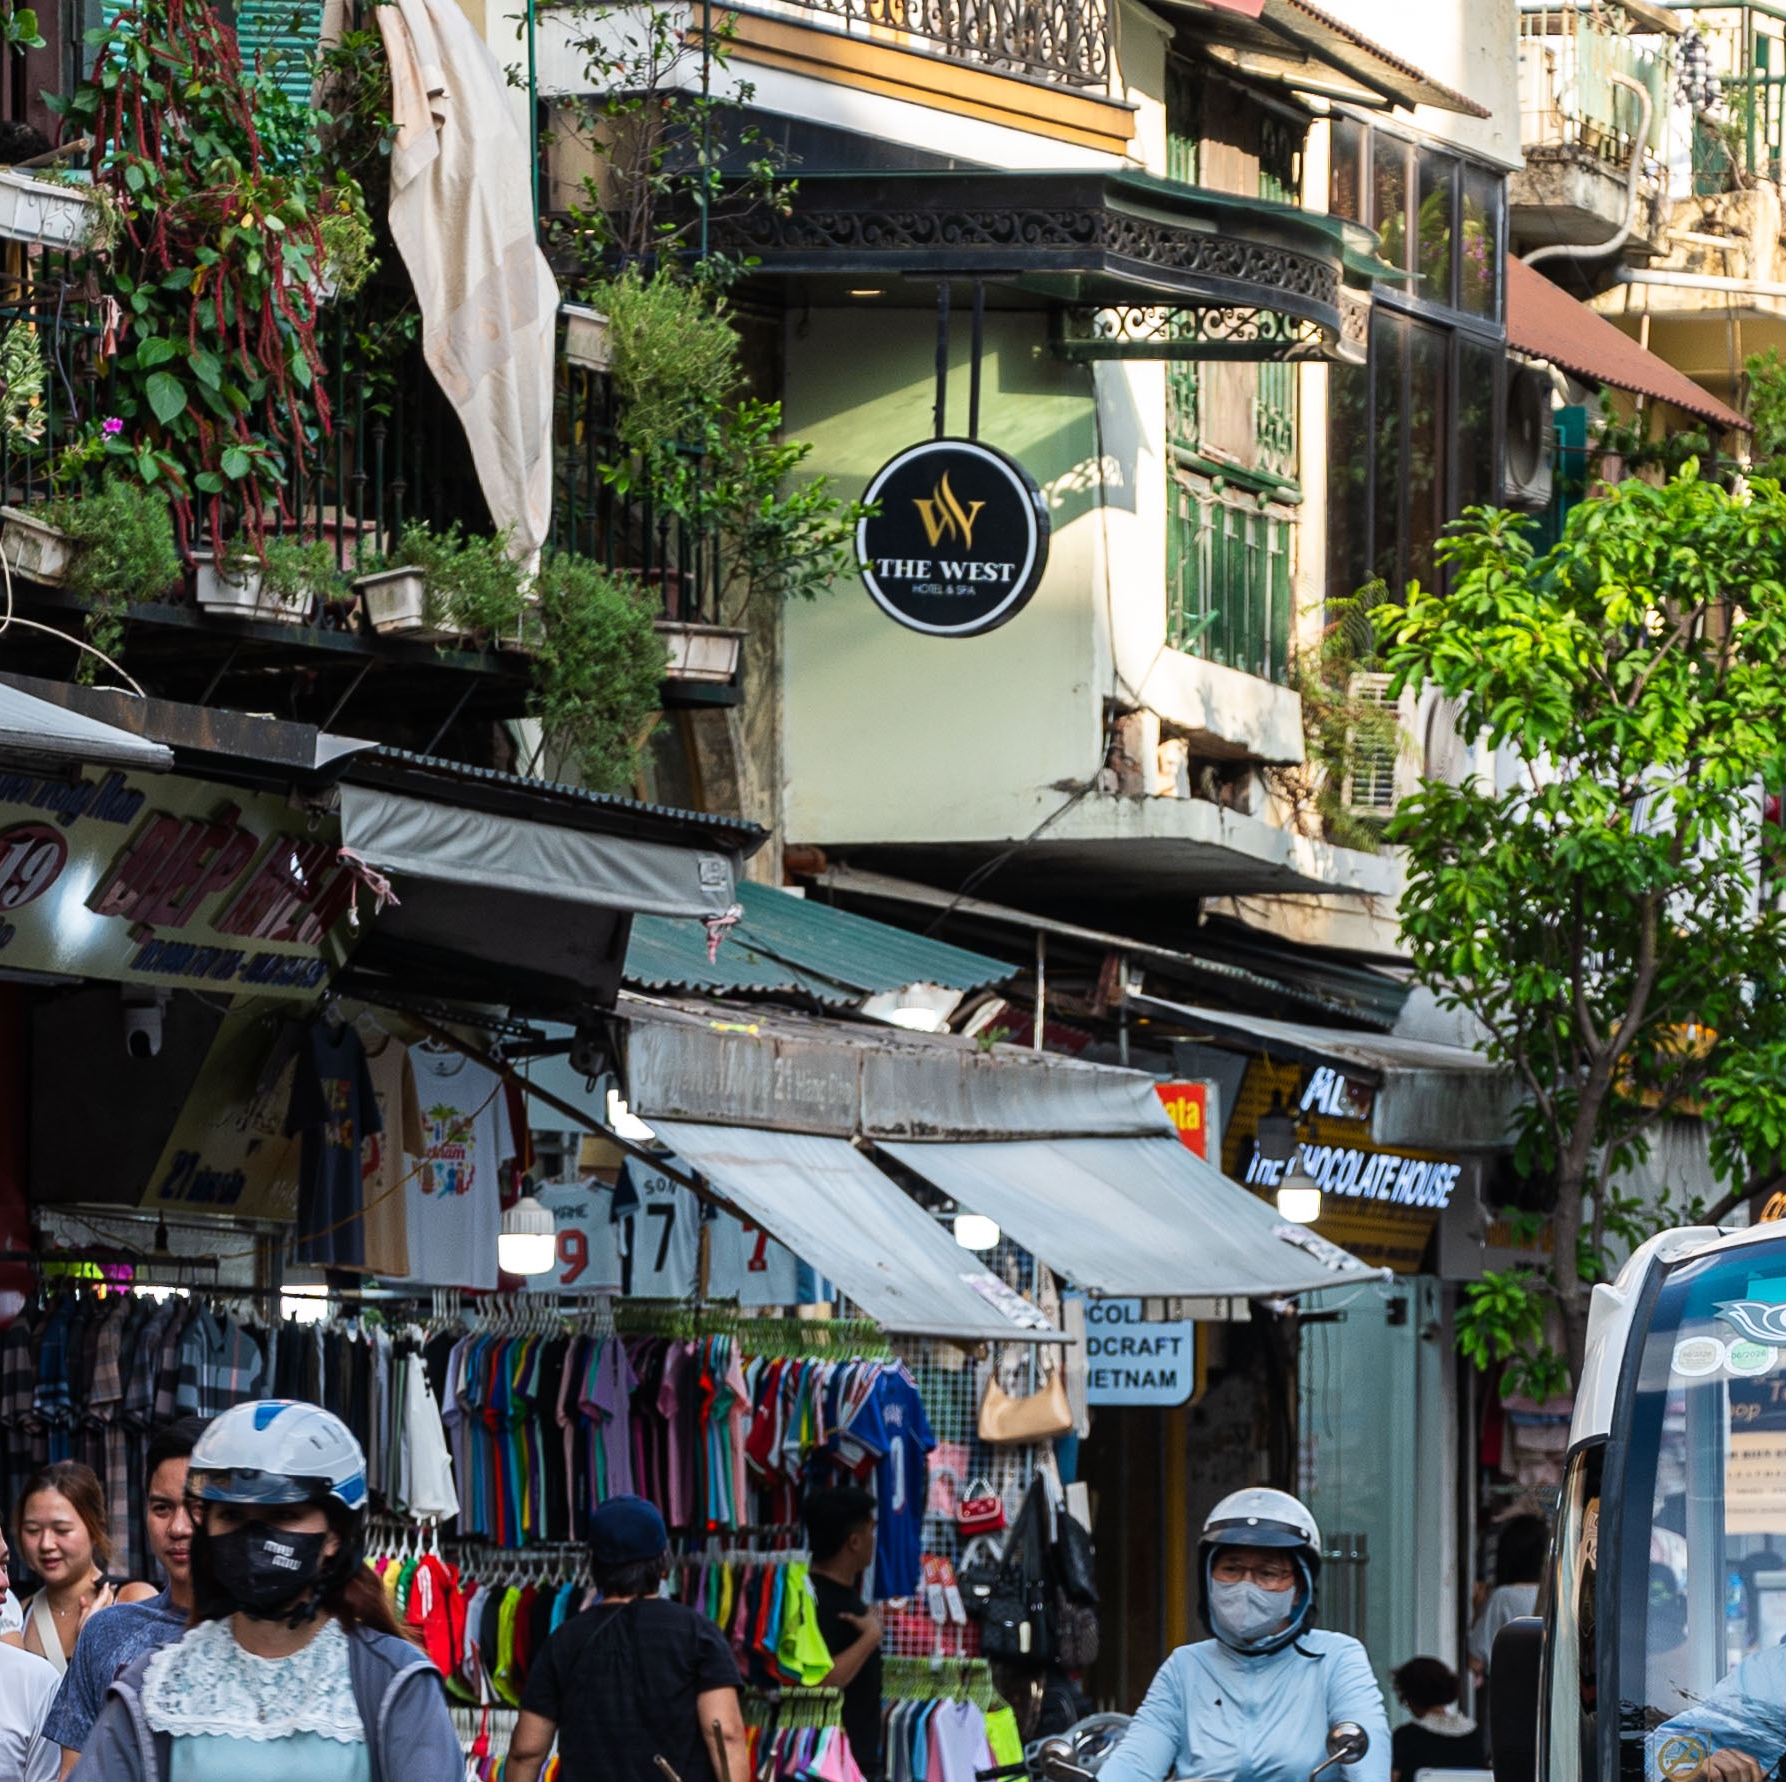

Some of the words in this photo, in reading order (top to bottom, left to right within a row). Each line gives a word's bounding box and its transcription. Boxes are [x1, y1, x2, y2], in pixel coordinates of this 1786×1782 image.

[877, 558, 931, 580] THE
[940, 560, 1016, 583] WEST
[913, 584, 943, 596] HOTEL
[945, 585, 954, 596] &
[956, 585, 976, 597] SPA
[1391, 1159, 1461, 1208] HOUSE
[647, 1203, 675, 1272] 7
[556, 1228, 589, 1285] 9
[1087, 1337, 1183, 1356] DCRAFT
